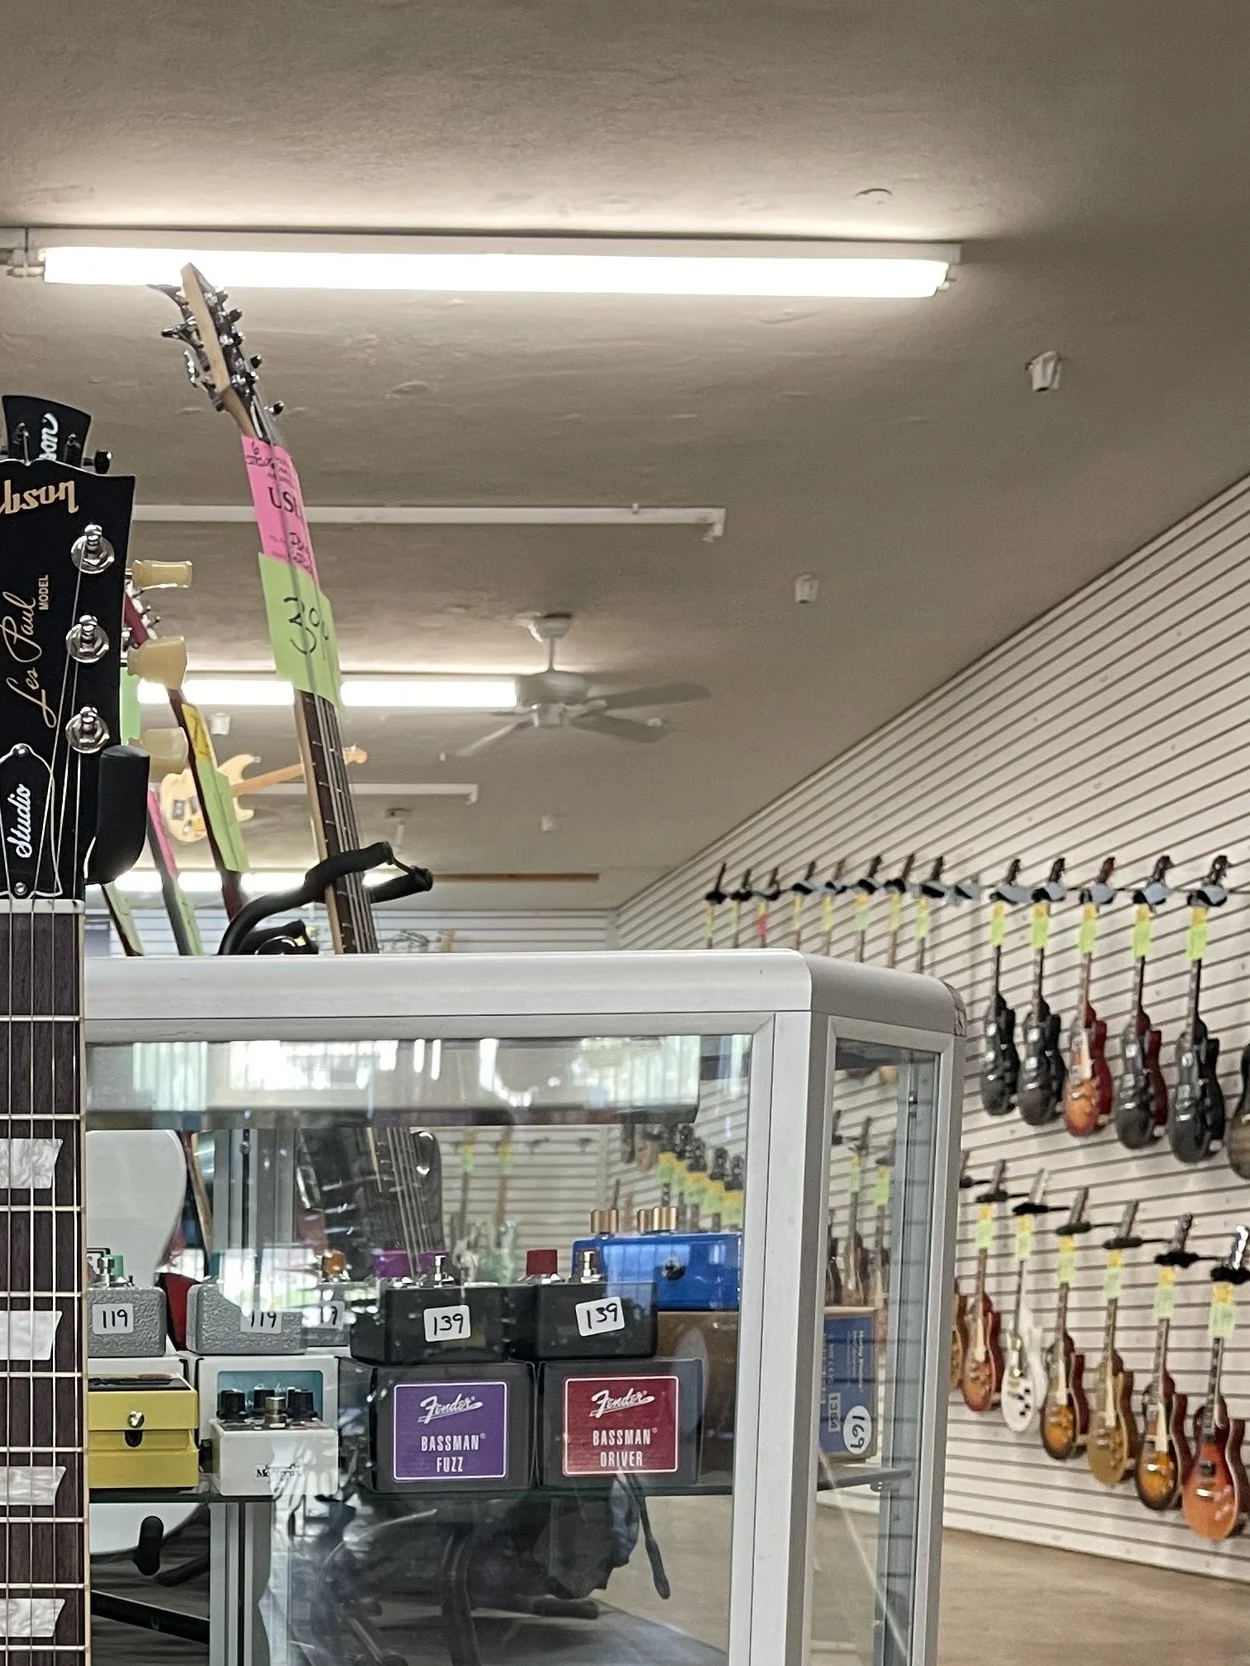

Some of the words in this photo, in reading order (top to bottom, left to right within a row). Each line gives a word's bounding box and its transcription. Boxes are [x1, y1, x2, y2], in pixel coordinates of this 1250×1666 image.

[38, 574, 49, 611] MODEL
[6, 667, 57, 728] Les
[6, 782, 33, 860] Studio
[101, 1309, 129, 1329] 119
[432, 1312, 464, 1336] 139
[585, 1302, 619, 1330] 139
[417, 1393, 483, 1424] Fender
[589, 1387, 655, 1418] Fender
[849, 1415, 867, 1450] 169
[435, 1456, 464, 1473] FUZZ
[600, 1451, 643, 1468] DRIVER
